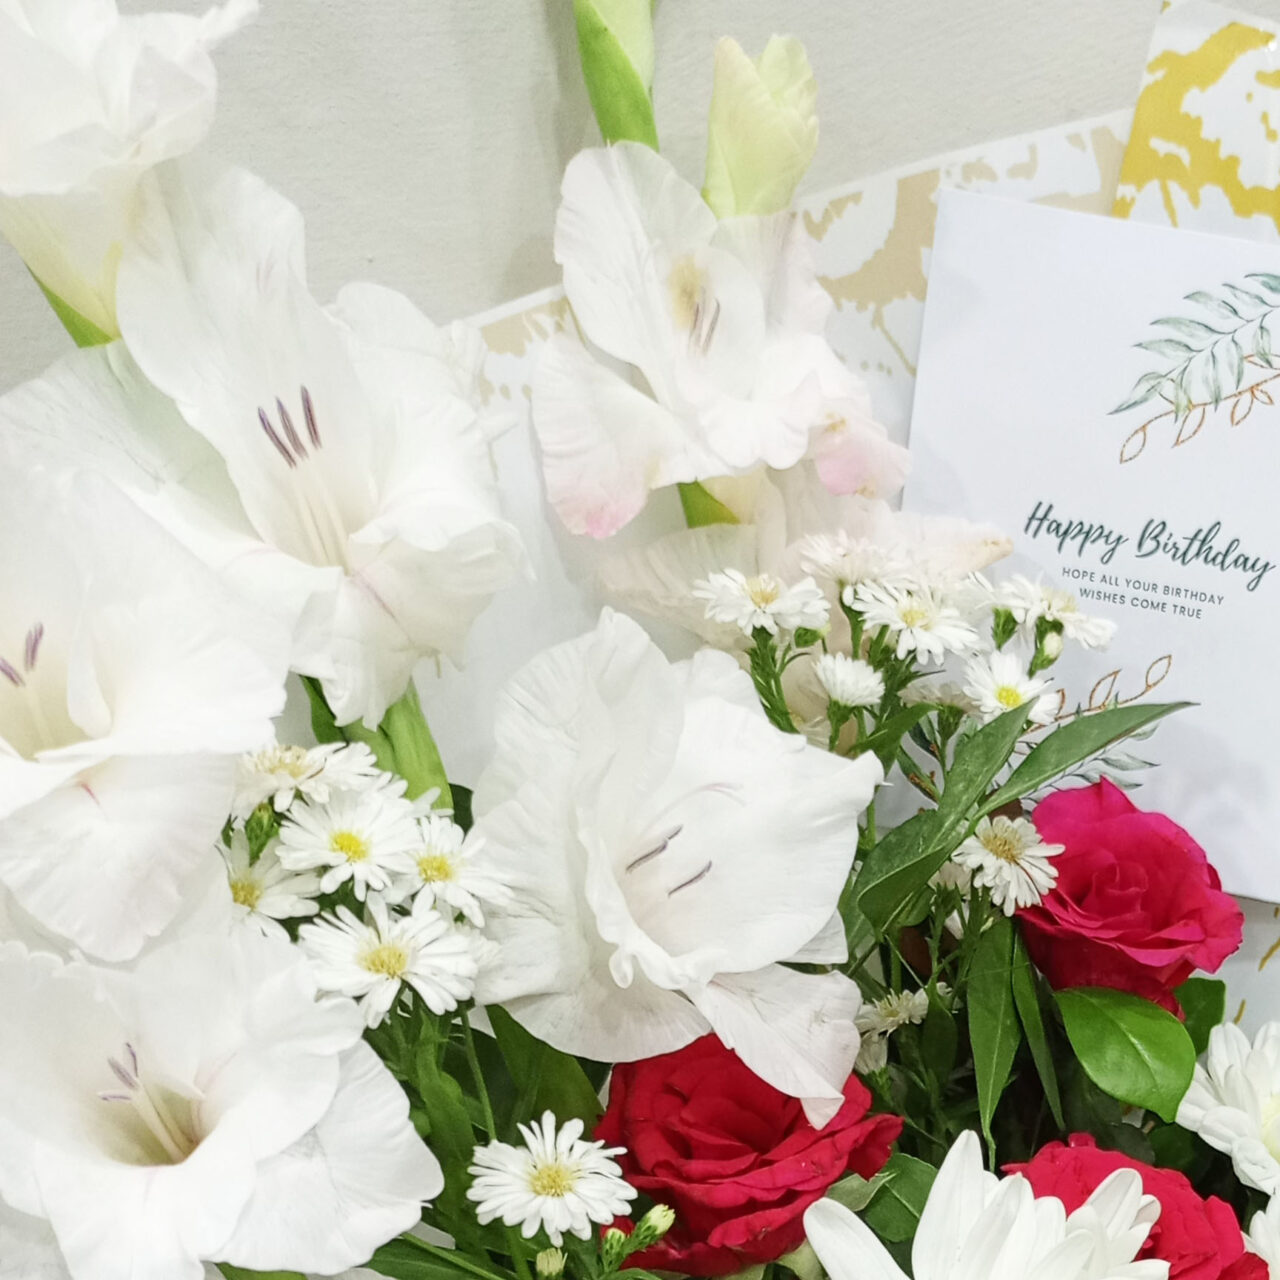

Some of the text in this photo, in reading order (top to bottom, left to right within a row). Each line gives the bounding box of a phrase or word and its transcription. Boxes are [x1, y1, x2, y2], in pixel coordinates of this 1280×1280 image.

[1024, 500, 1277, 592] Happy Birthday
[1062, 567, 1225, 606] HOPE ALL YOUR BIRTHDAY
[1079, 587, 1203, 620] WISHES COME TRUE
